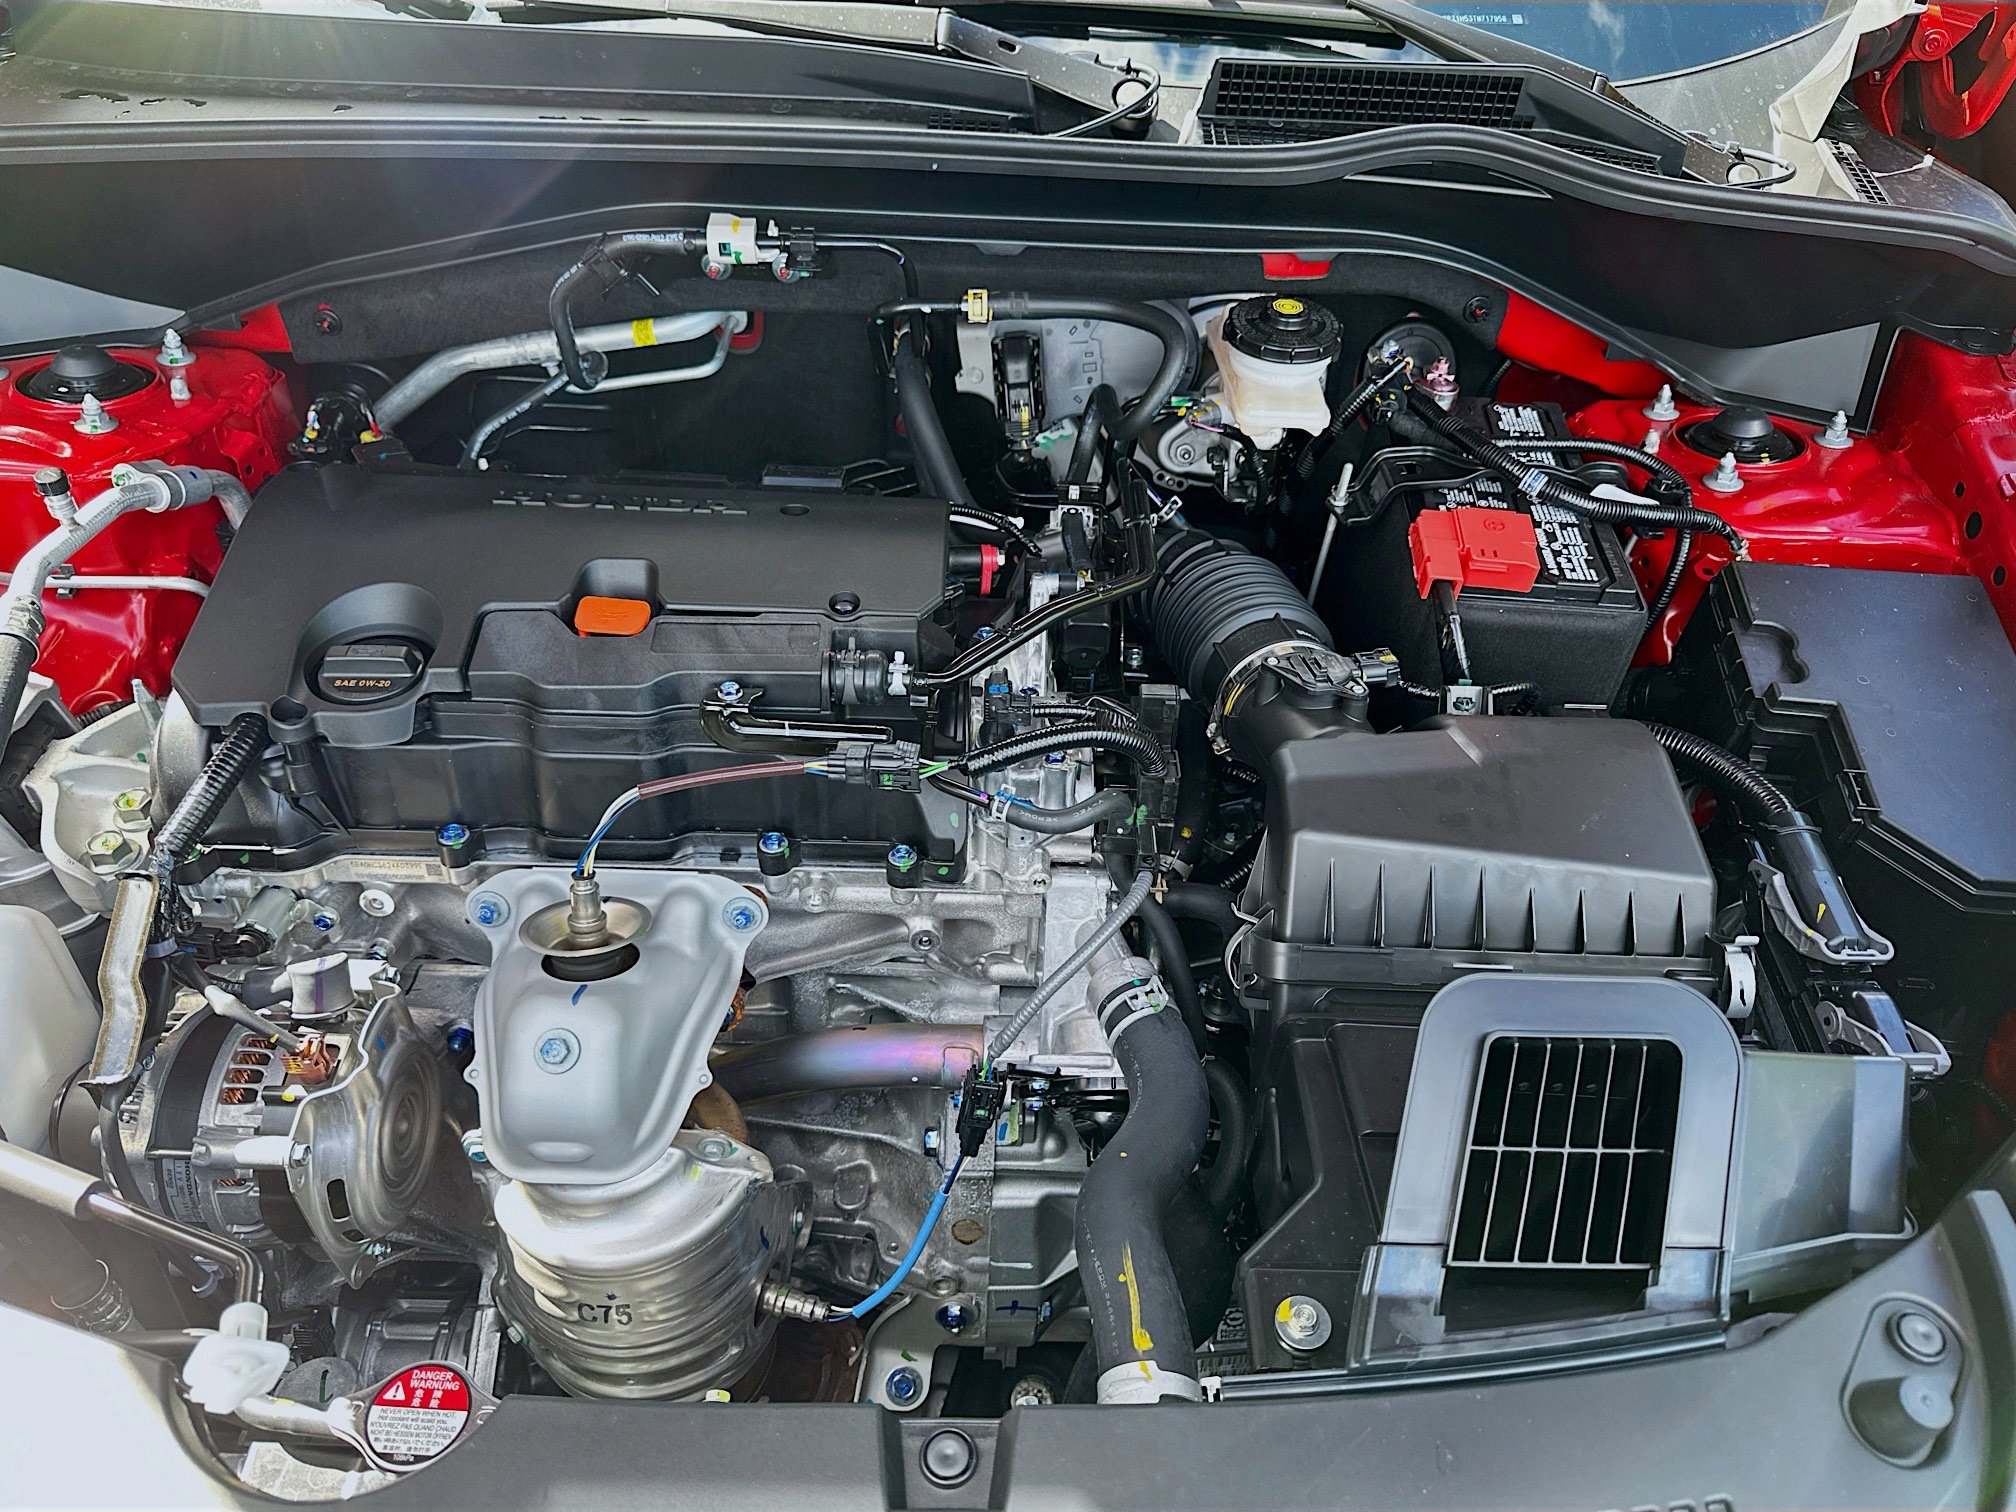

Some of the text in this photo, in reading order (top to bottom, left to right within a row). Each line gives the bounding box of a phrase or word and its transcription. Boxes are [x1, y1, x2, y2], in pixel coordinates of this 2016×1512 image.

[334, 679, 391, 687] SAE 0W-20
[578, 1302, 633, 1326] C75
[412, 1370, 453, 1380] DANGER
[410, 1379, 459, 1390] WARNUNG
